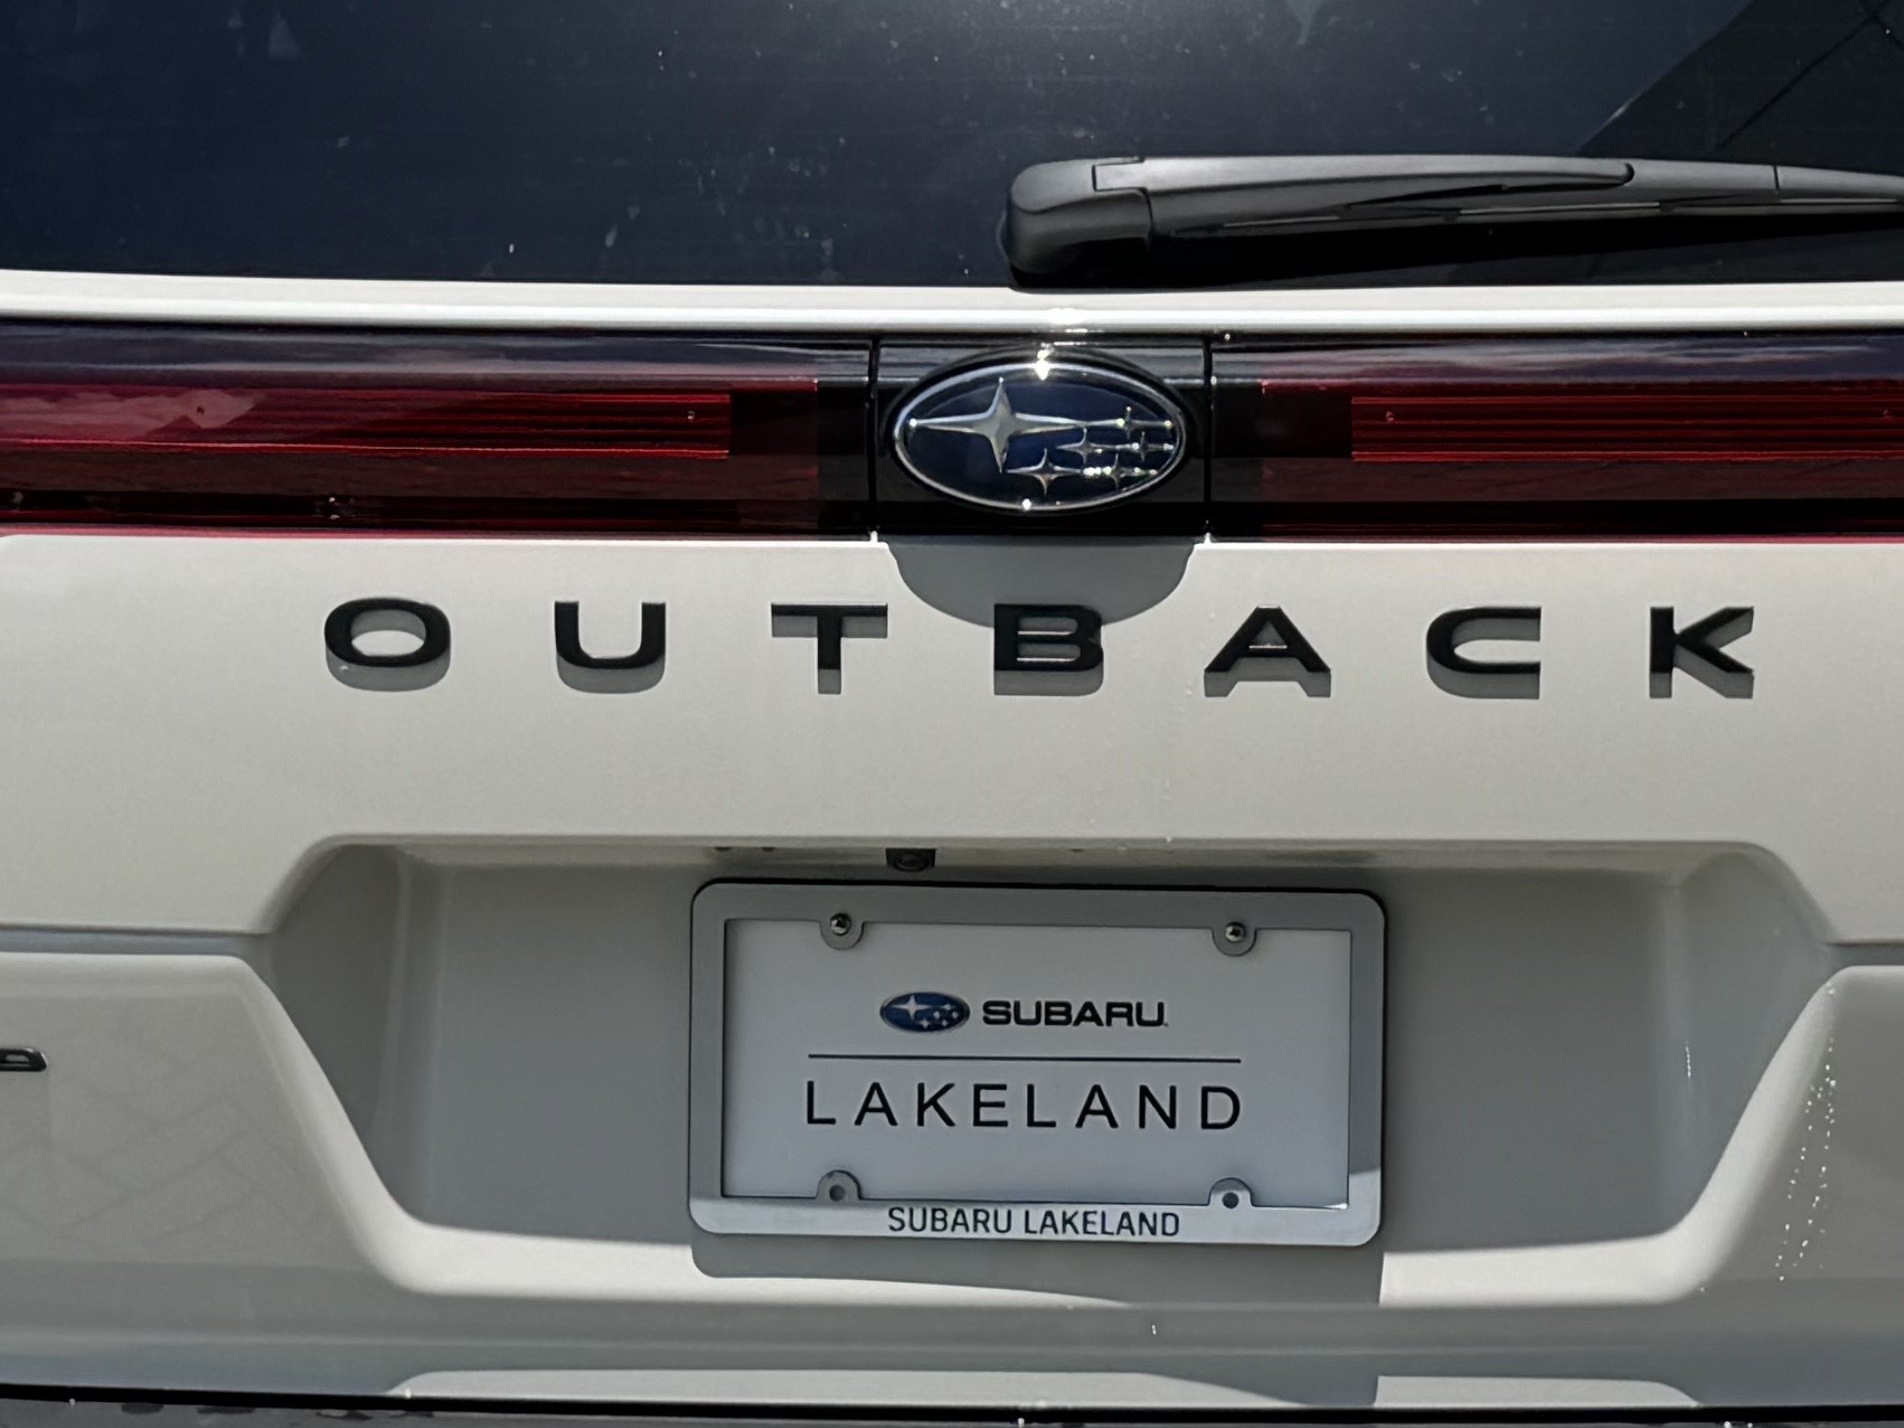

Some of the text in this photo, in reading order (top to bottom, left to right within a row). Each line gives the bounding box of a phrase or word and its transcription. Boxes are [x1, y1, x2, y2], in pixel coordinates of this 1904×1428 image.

[323, 596, 1755, 696] OUTBACK
[981, 999, 1165, 1027] SUBARU
[806, 1080, 1242, 1130] LAKELAND
[887, 1205, 1181, 1238] SUBARU LAKELAND
